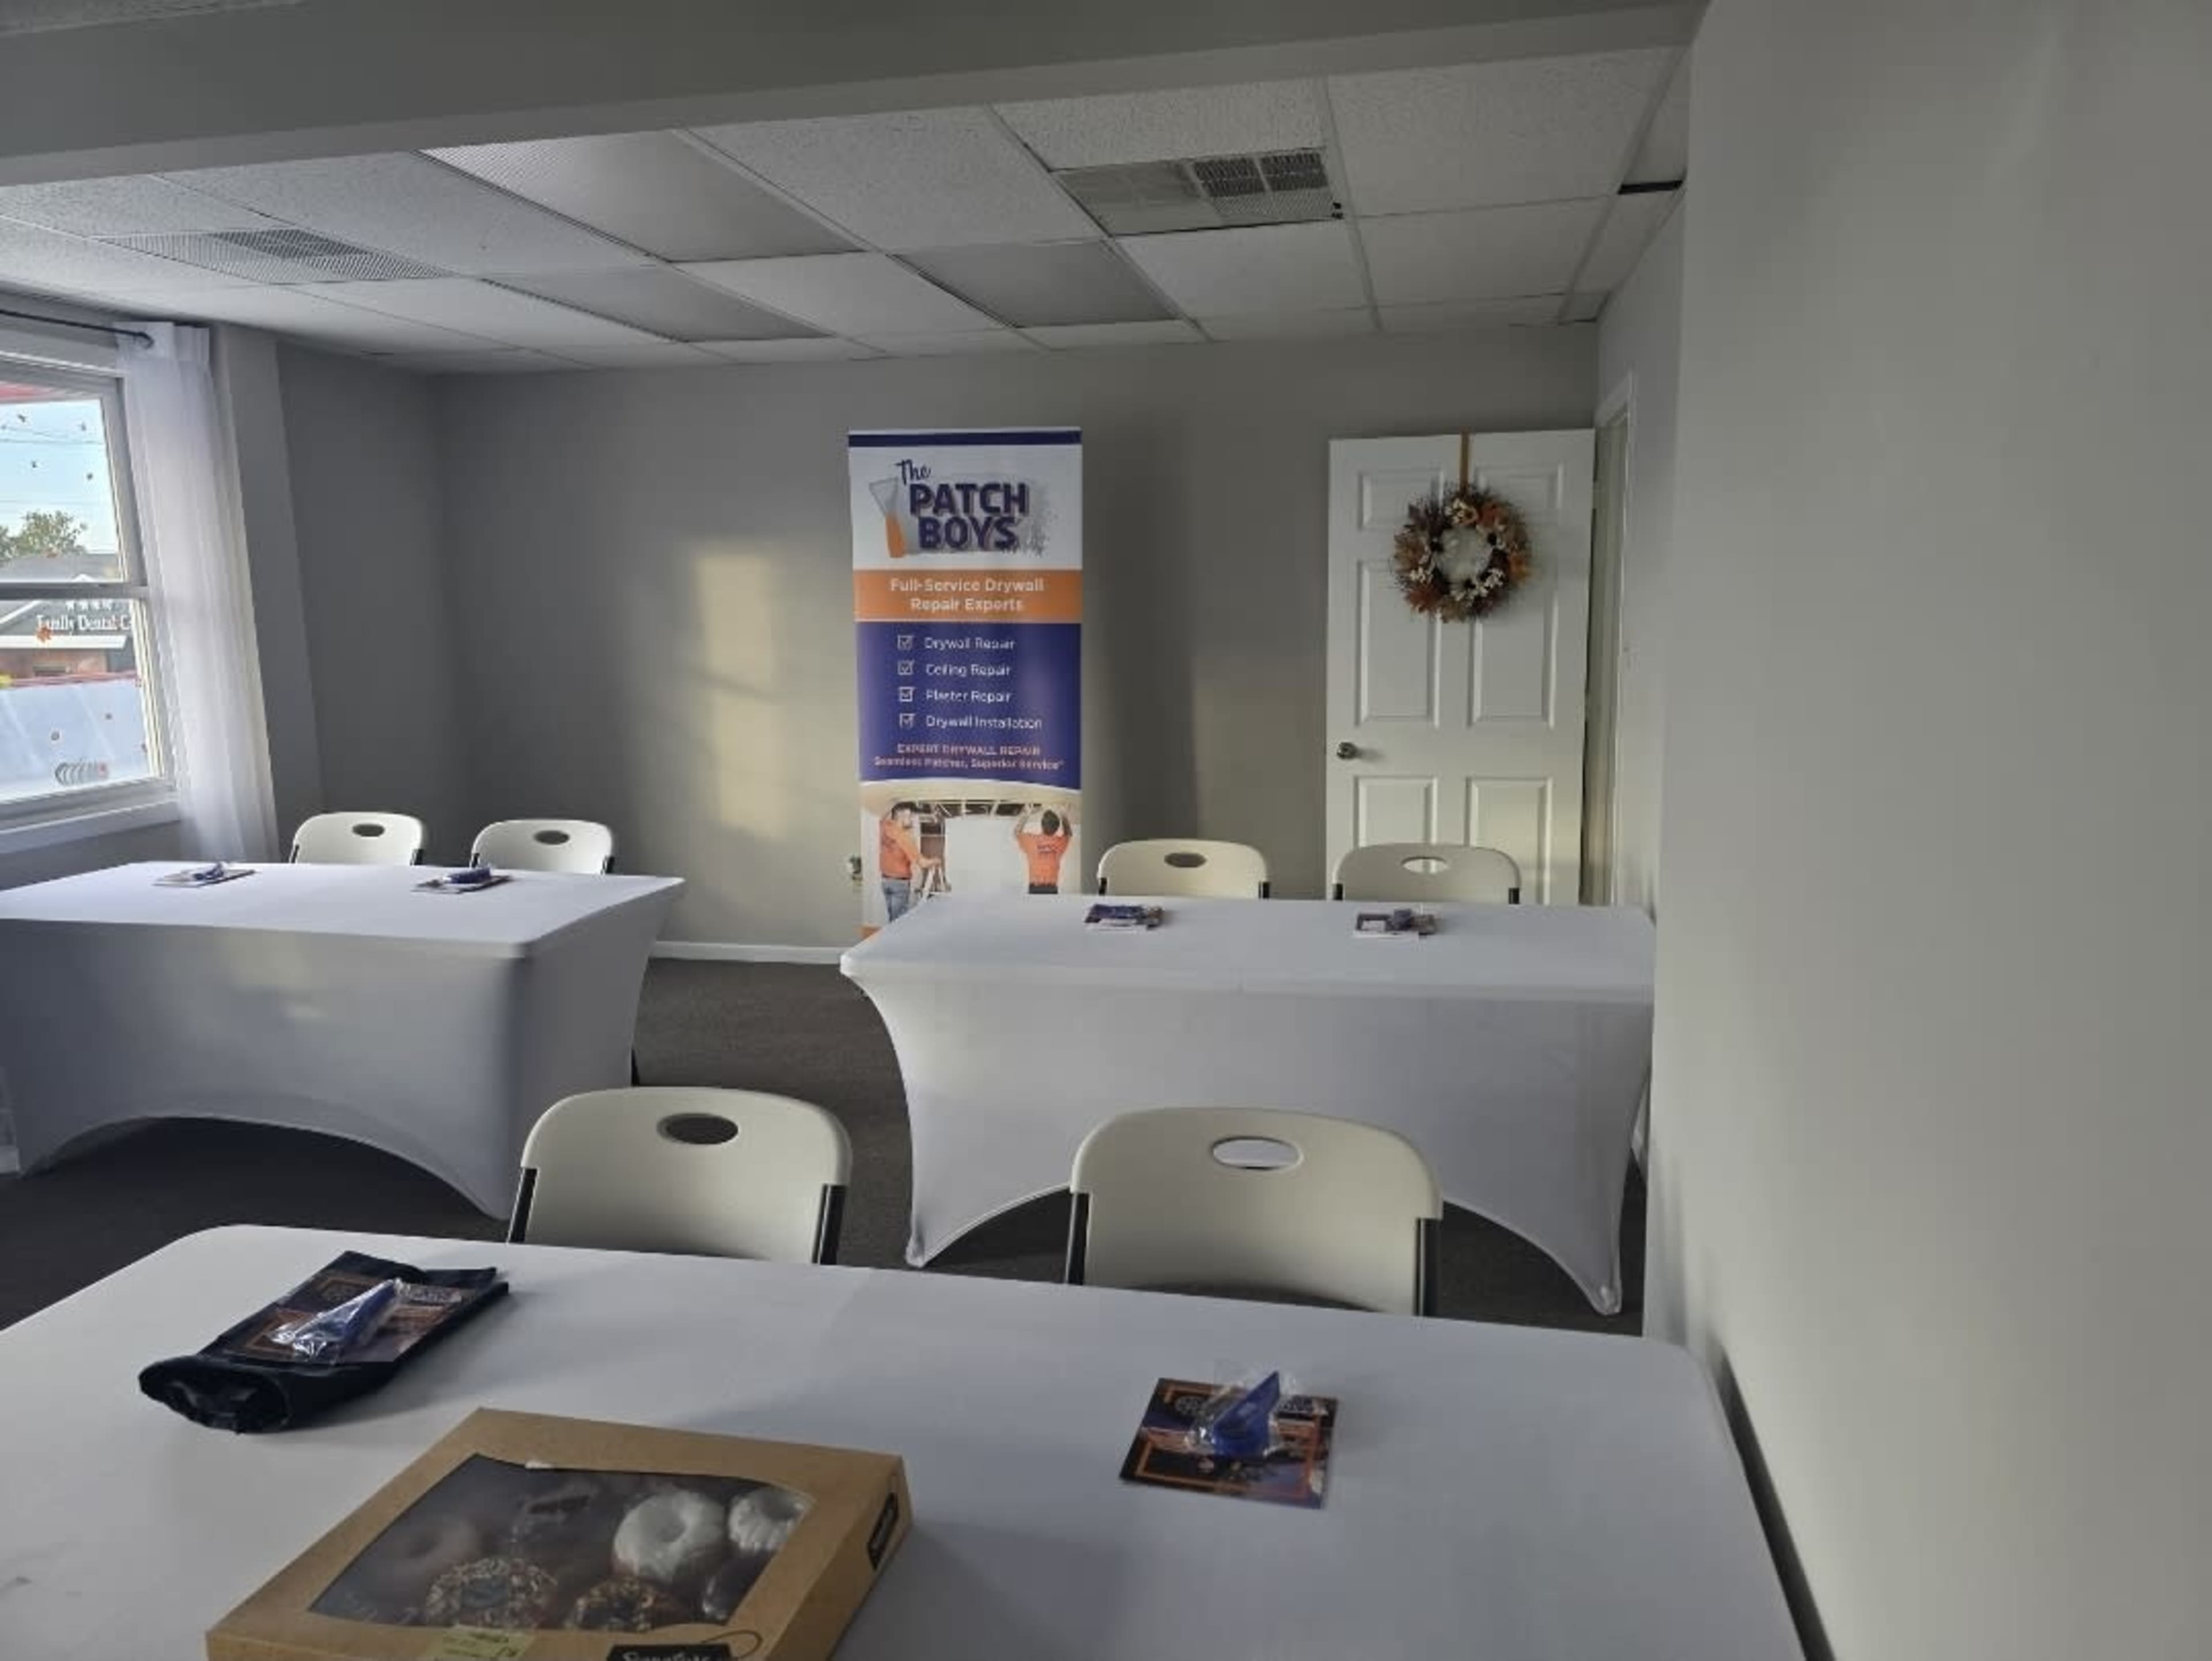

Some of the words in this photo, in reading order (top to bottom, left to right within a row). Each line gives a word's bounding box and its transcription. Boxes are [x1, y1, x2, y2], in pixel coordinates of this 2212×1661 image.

[895, 459, 931, 485] The
[910, 483, 1027, 514] PATCH
[918, 516, 1017, 549] BOYS
[890, 578, 979, 592] Full-Service
[985, 578, 1044, 593] Drywall
[911, 597, 960, 612] Repair
[965, 598, 1023, 612] Experts
[925, 637, 971, 650] Drywall
[975, 637, 1016, 650] Repair
[926, 664, 967, 678] Ceiling
[971, 664, 1011, 678] Repair
[926, 690, 968, 701] Plaster
[971, 690, 1011, 703] Repair
[926, 715, 972, 729] Drywall
[975, 715, 1043, 729] Installation
